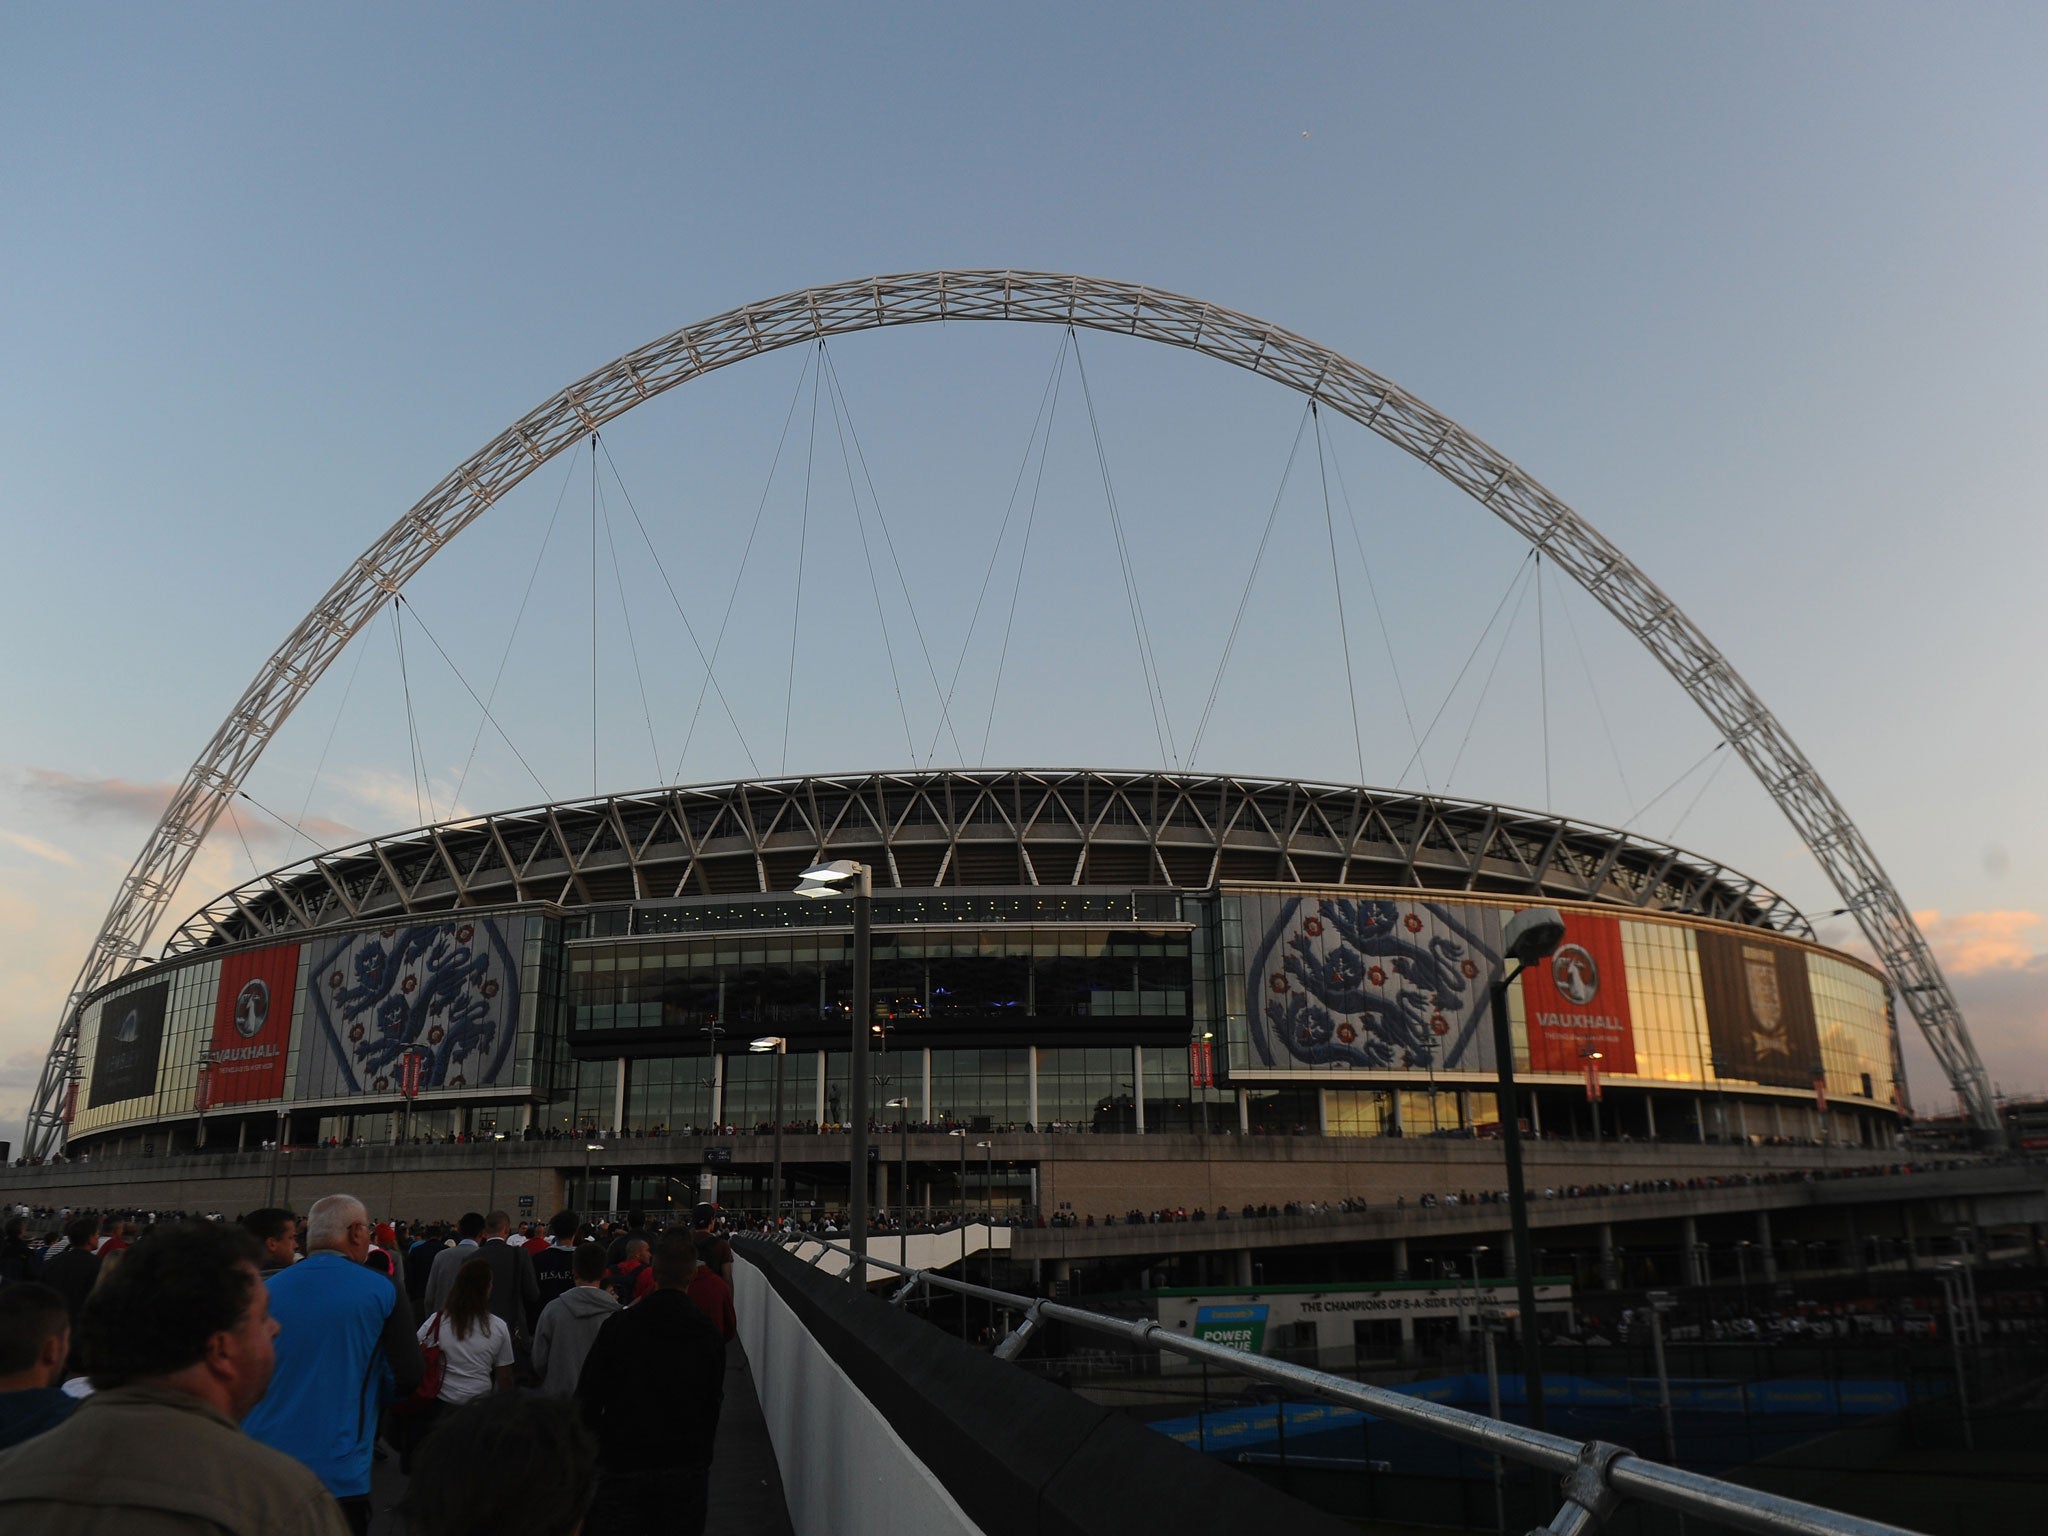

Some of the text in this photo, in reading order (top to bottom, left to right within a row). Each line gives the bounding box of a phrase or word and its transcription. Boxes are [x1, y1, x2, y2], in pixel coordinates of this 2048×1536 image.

[1536, 1012, 1624, 1031] VAUXHALL
[216, 1043, 280, 1062] VAUXHALL
[1300, 1302, 1322, 1312] THE
[1324, 1299, 1387, 1311] CHAMPIONS
[1388, 1299, 1401, 1309] OF
[1203, 1329, 1252, 1341] POWER
